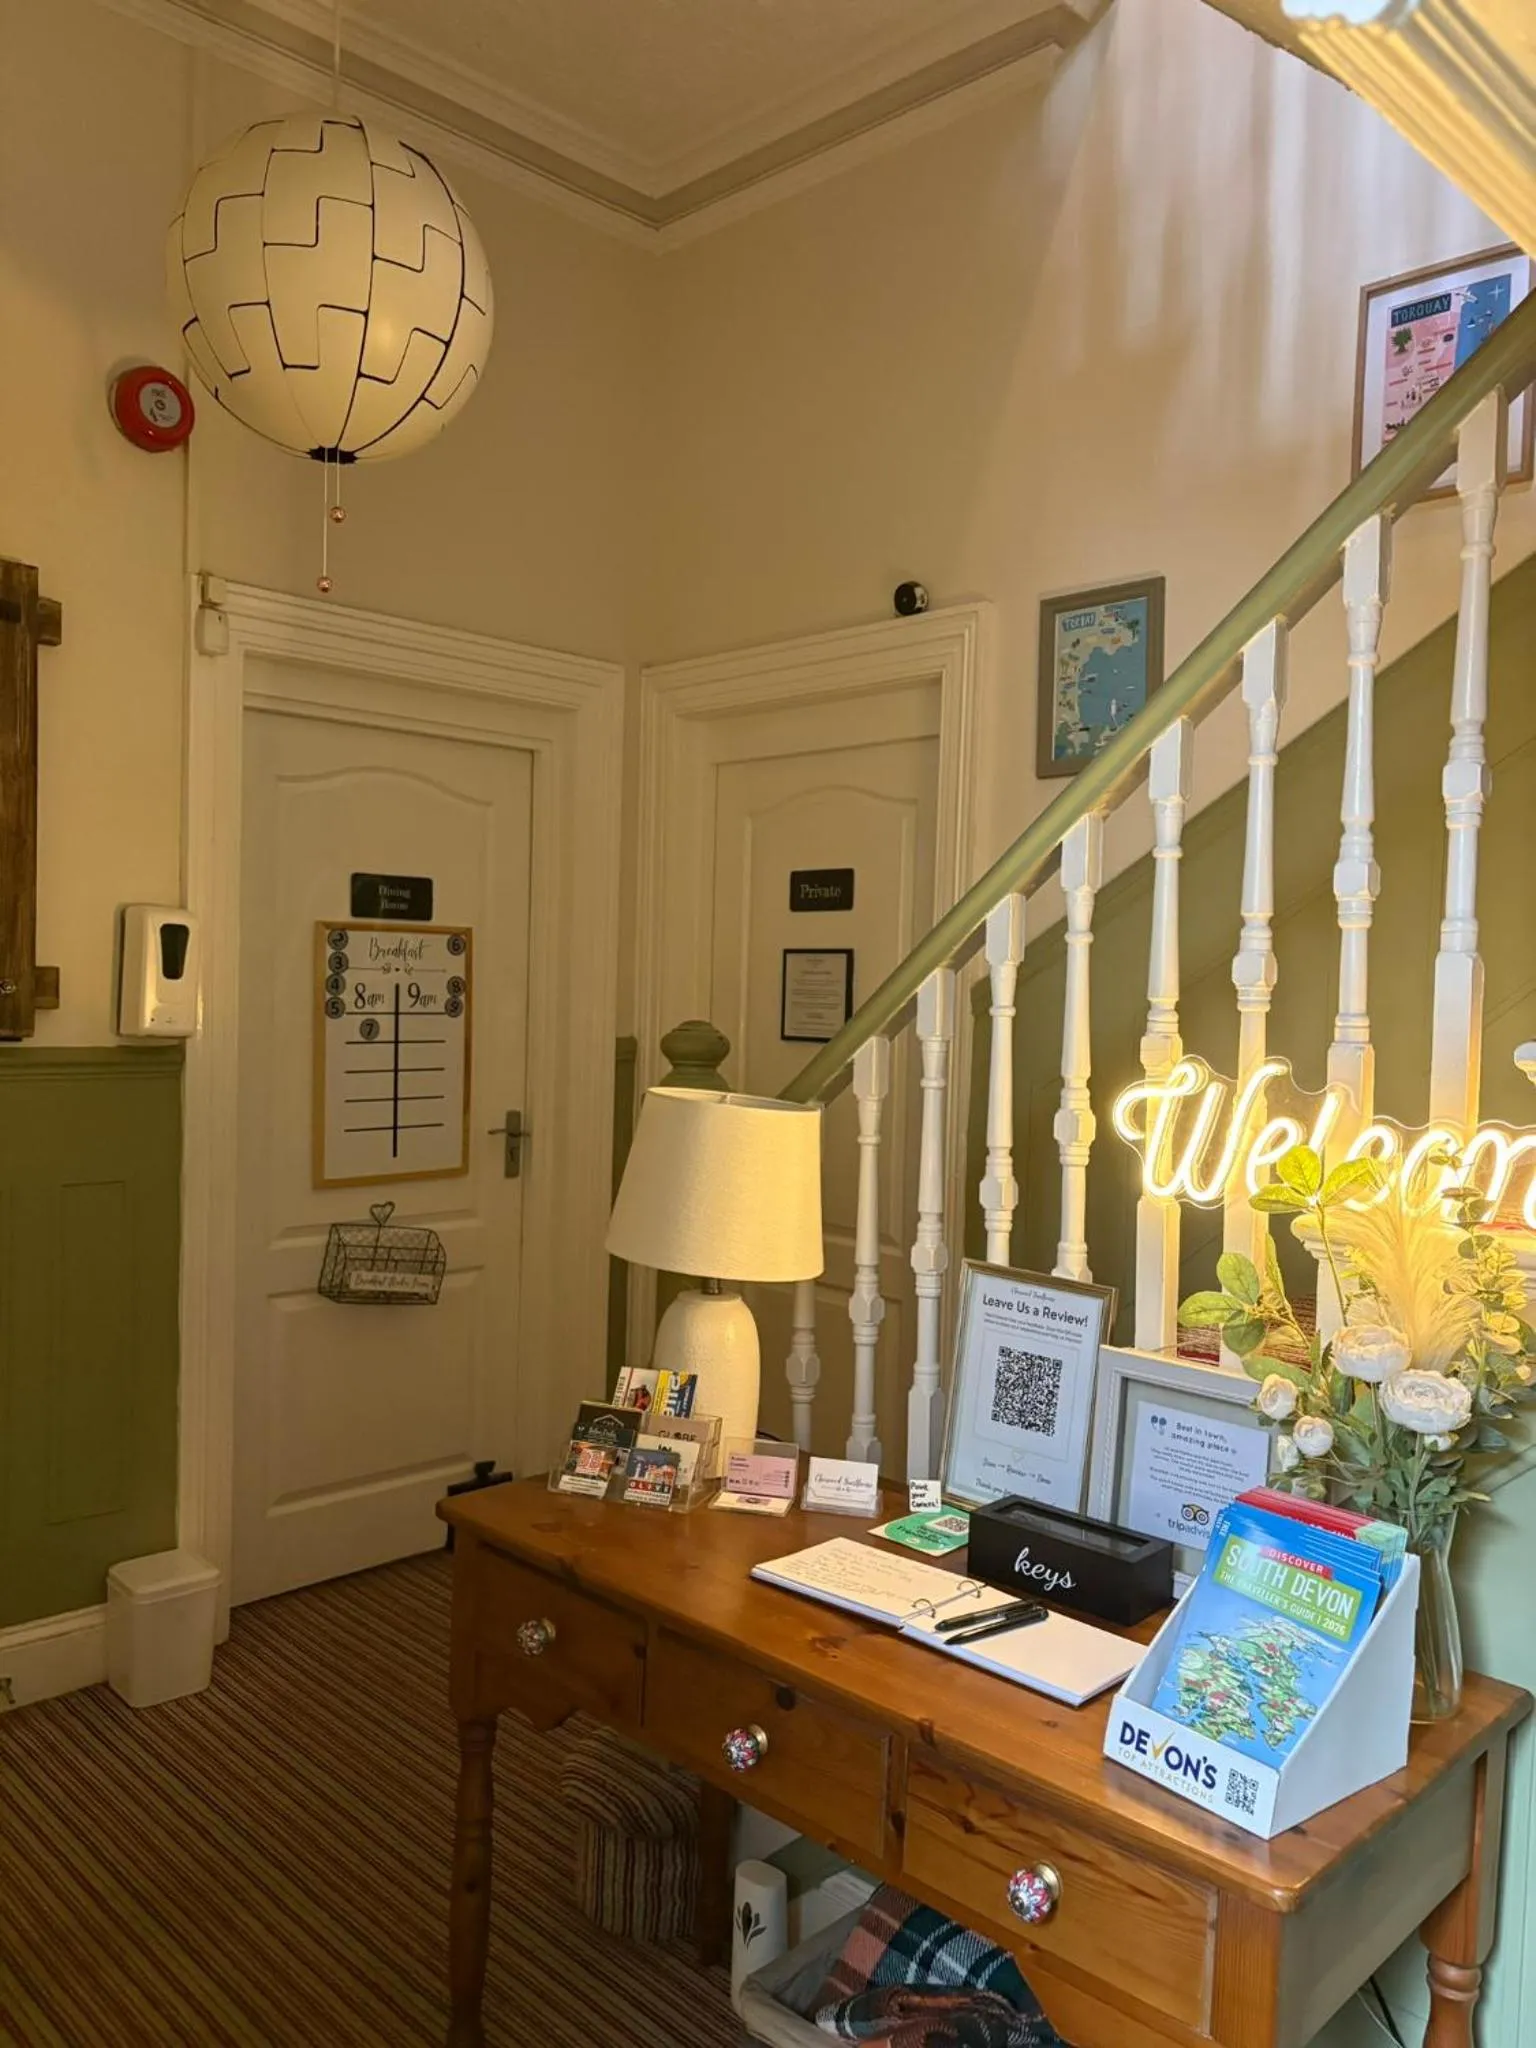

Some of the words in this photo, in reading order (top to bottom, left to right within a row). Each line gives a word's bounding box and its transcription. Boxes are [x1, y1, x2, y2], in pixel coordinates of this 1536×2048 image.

[1393, 296, 1450, 324] TORQUAY
[800, 884, 842, 899] Private
[368, 936, 428, 961] Breakfast
[983, 1294, 1013, 1310] Leave
[1017, 1301, 1030, 1314] Us
[1033, 1307, 1040, 1316] a
[1043, 1306, 1089, 1328] Review!
[1171, 1433, 1205, 1448] amazing
[1176, 1422, 1193, 1433] Best
[1195, 1426, 1202, 1434] in
[911, 1481, 928, 1491] Point
[1013, 1547, 1077, 1591] keys
[1268, 1549, 1324, 1575] DISCOVER
[1226, 1544, 1289, 1590] SOUTH
[1290, 1572, 1355, 1619] DEVON
[1289, 1603, 1315, 1623] GUIDE
[1119, 1720, 1218, 1790] DEVON'S
[1117, 1746, 1136, 1763] TOP
[1140, 1759, 1214, 1804] ATTRACTIONS
